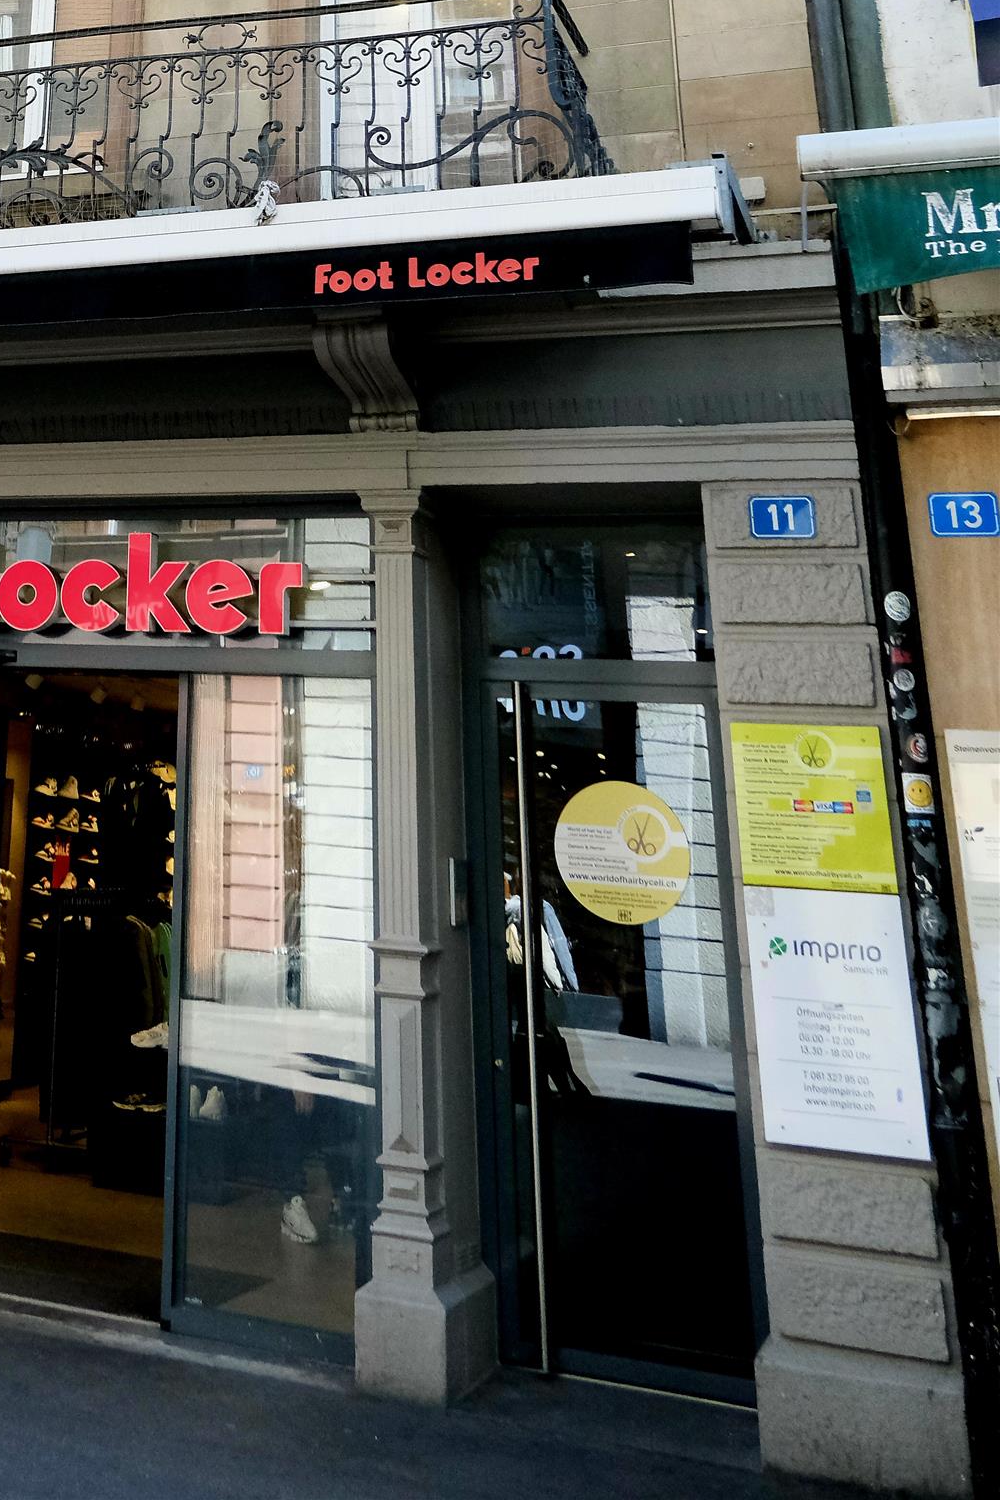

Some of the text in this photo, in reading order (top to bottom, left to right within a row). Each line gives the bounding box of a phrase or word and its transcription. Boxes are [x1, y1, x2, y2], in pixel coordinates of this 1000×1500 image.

[924, 239, 988, 258] The
[314, 251, 540, 295] Foot Locker
[766, 503, 796, 531] 11
[945, 500, 984, 529] 13
[816, 801, 834, 811] VISA
[792, 940, 882, 964] impirio
